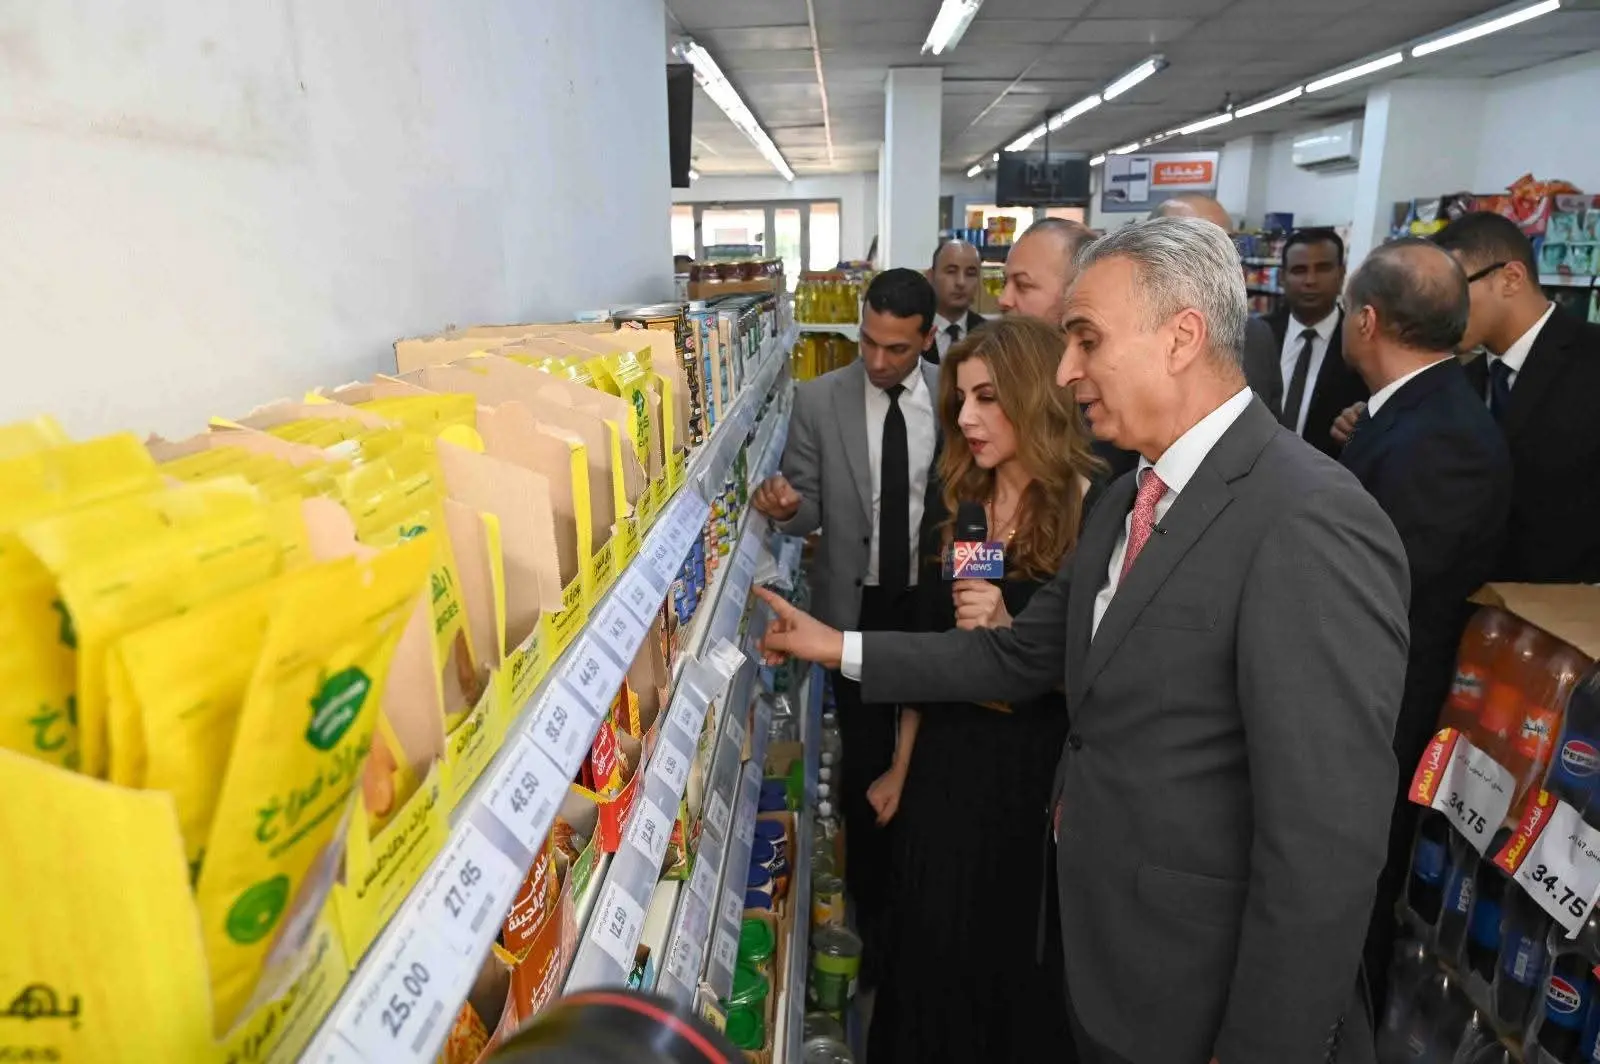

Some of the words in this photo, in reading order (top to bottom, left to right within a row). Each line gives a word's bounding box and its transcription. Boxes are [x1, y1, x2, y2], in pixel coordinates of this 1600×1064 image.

[953, 541, 1004, 564] eXtra
[965, 562, 992, 571] news
[510, 771, 540, 815] 48.50
[1447, 791, 1488, 835] 34.75
[1504, 834, 1528, 871] سعر
[443, 858, 483, 919] 27.95
[1531, 863, 1589, 918] 34.75
[608, 906, 628, 940] 12.50
[381, 961, 431, 1039] 25.00
[1550, 986, 1579, 1006] EPSI
